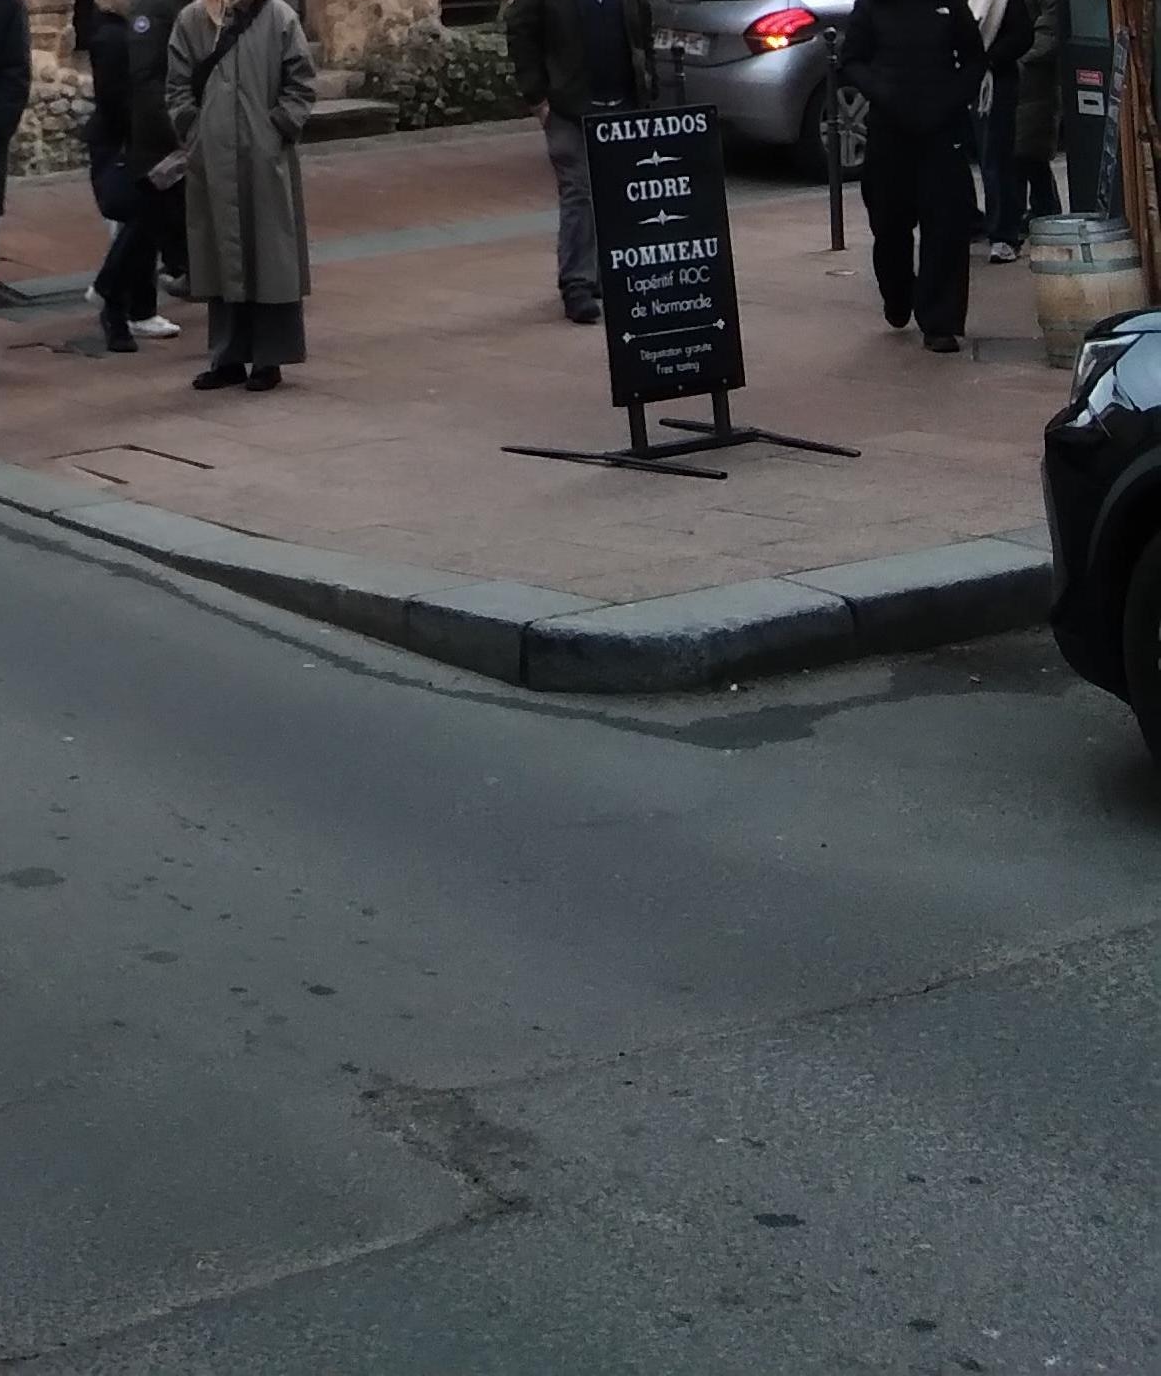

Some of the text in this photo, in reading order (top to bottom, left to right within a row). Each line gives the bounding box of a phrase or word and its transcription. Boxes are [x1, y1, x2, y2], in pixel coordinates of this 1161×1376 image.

[596, 113, 708, 143] CALVADOS
[626, 176, 692, 202] CIDRE
[610, 237, 718, 270] POMMEAU
[679, 265, 711, 285] AOC
[630, 293, 712, 319] de Normandie
